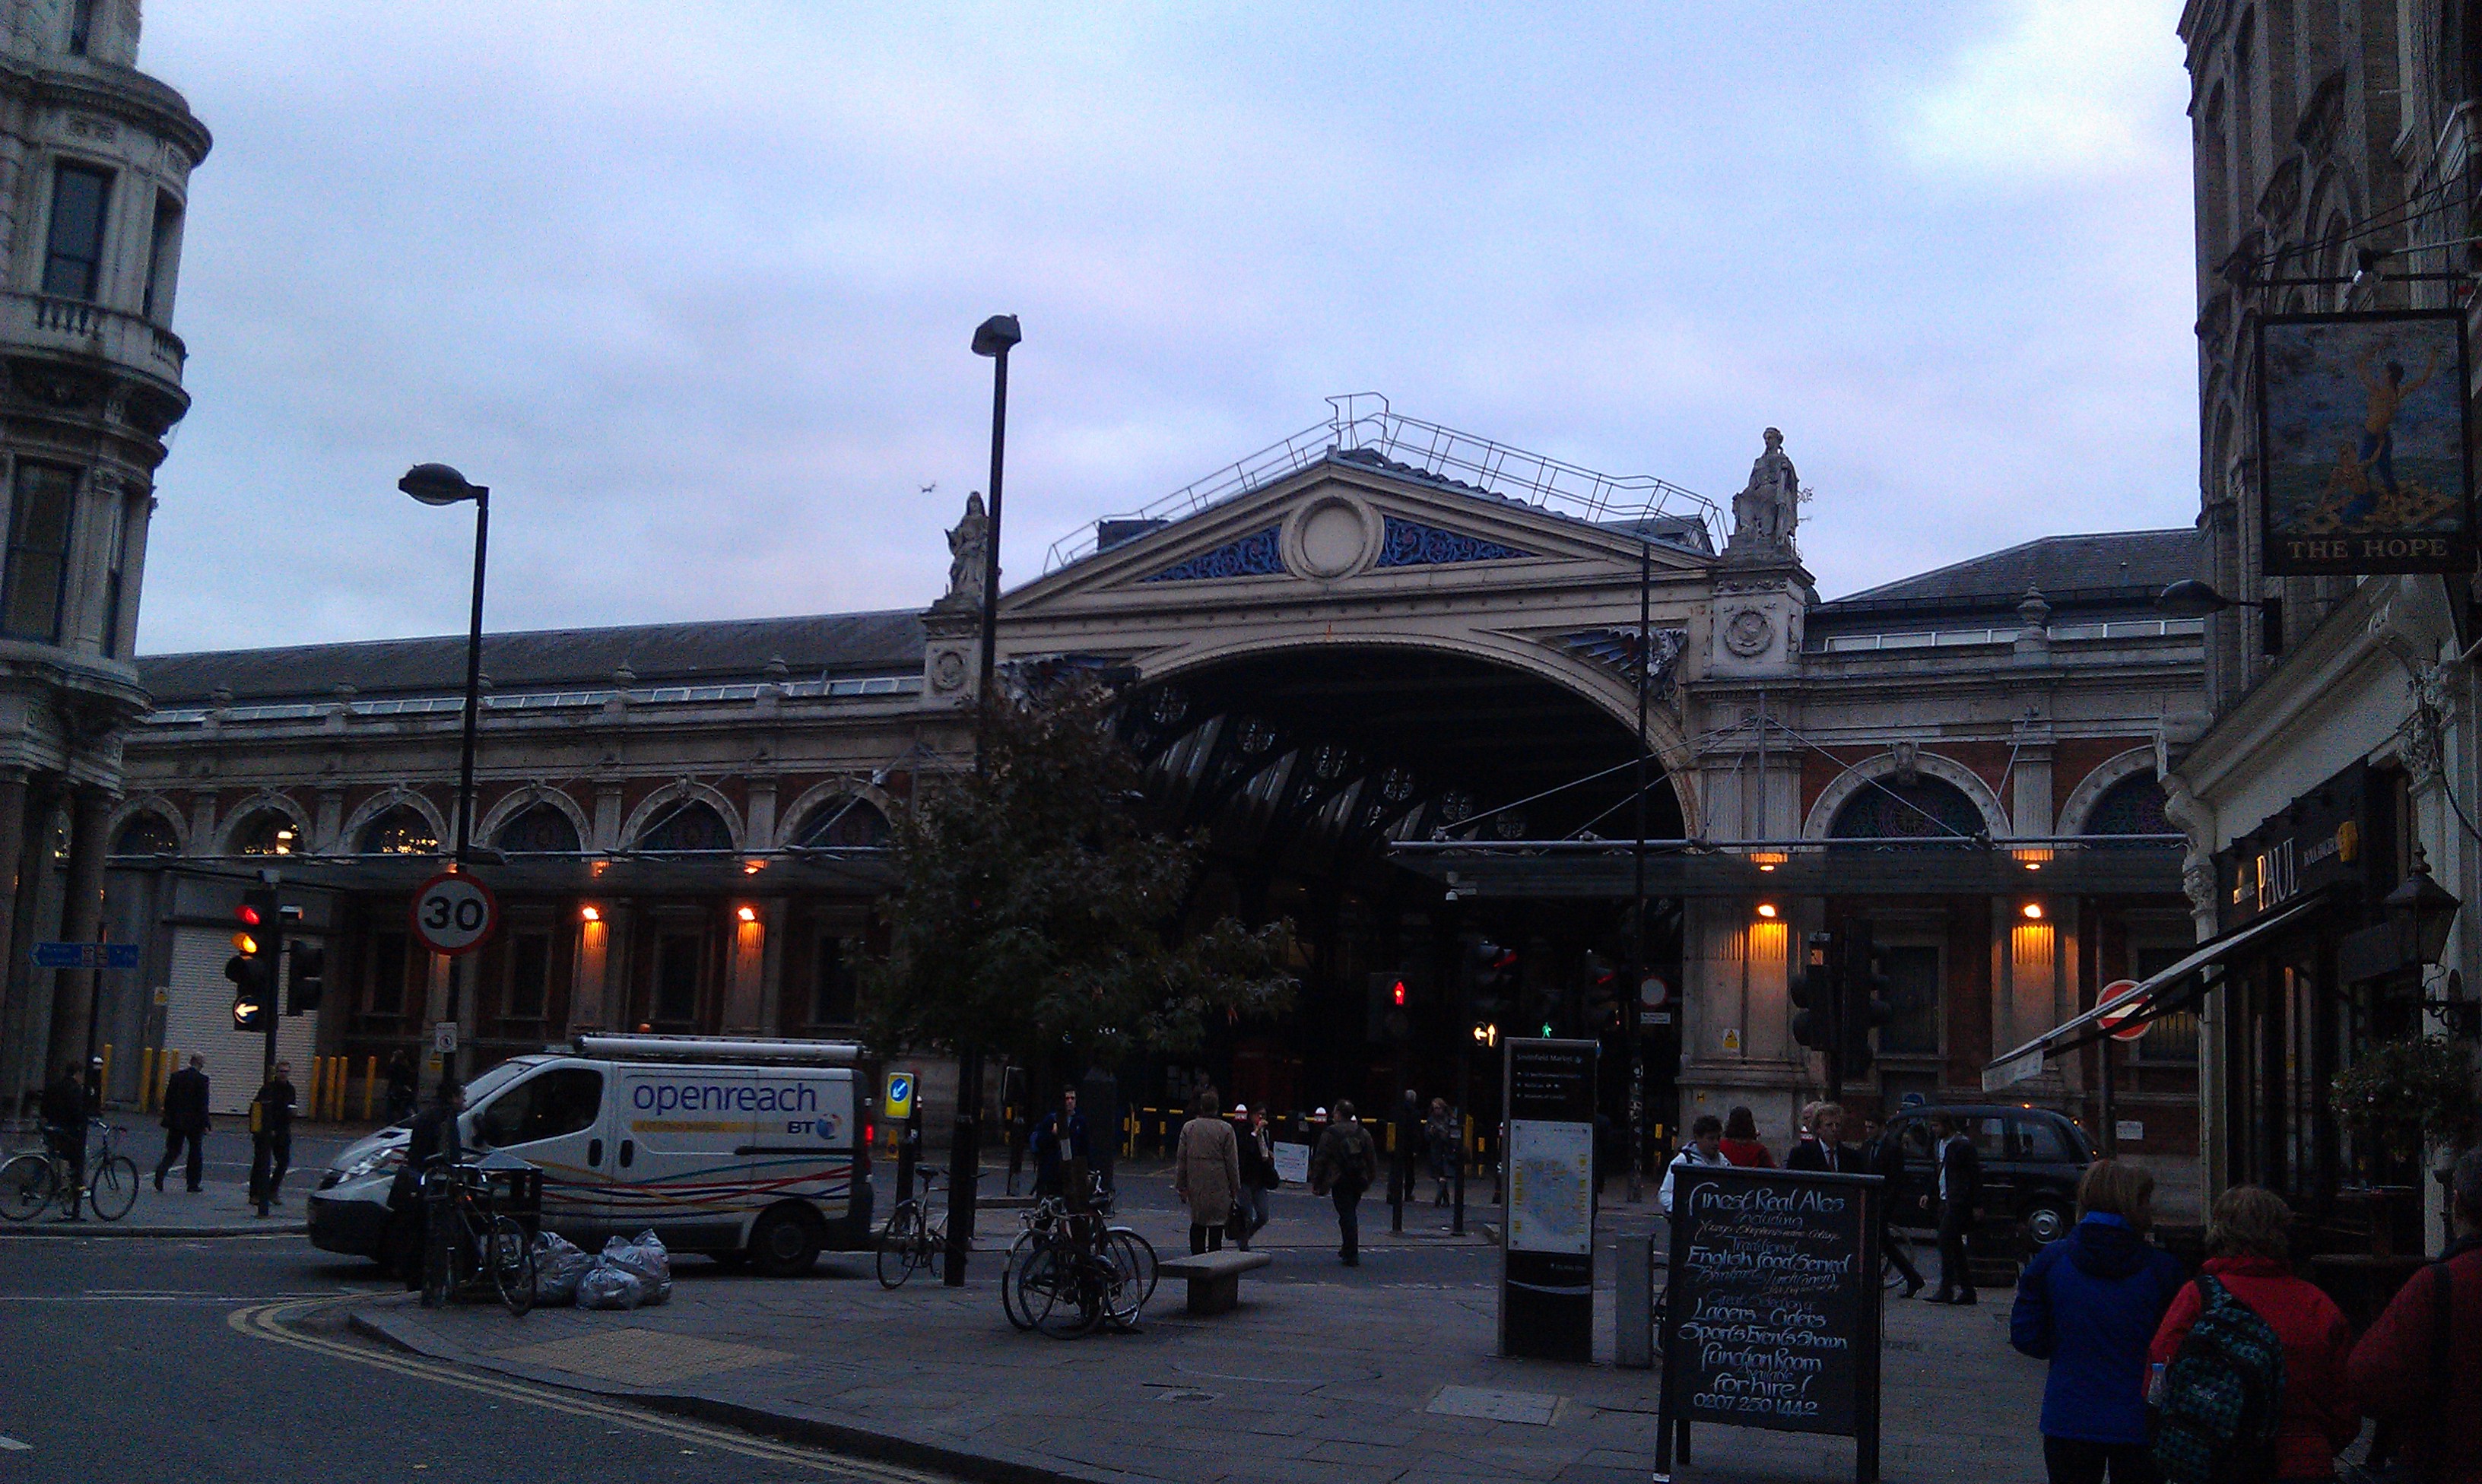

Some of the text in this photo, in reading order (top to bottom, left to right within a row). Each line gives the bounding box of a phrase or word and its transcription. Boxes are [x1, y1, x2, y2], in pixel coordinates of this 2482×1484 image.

[2287, 537, 2449, 560] THE HOPE
[2256, 837, 2300, 912] PAUL
[424, 896, 484, 931] 30
[633, 1082, 817, 1116] openreach
[787, 1121, 816, 1134] BT
[1754, 1188, 1798, 1213] Real
[1798, 1188, 1846, 1213] Ales
[1686, 1245, 1754, 1267] English
[1690, 1297, 1827, 1327] Lagers Ciders
[1677, 1321, 1848, 1350] Sports Events Shown
[1774, 1347, 1823, 1371] Room
[1693, 1392, 1819, 1418] 0207 250 1442
